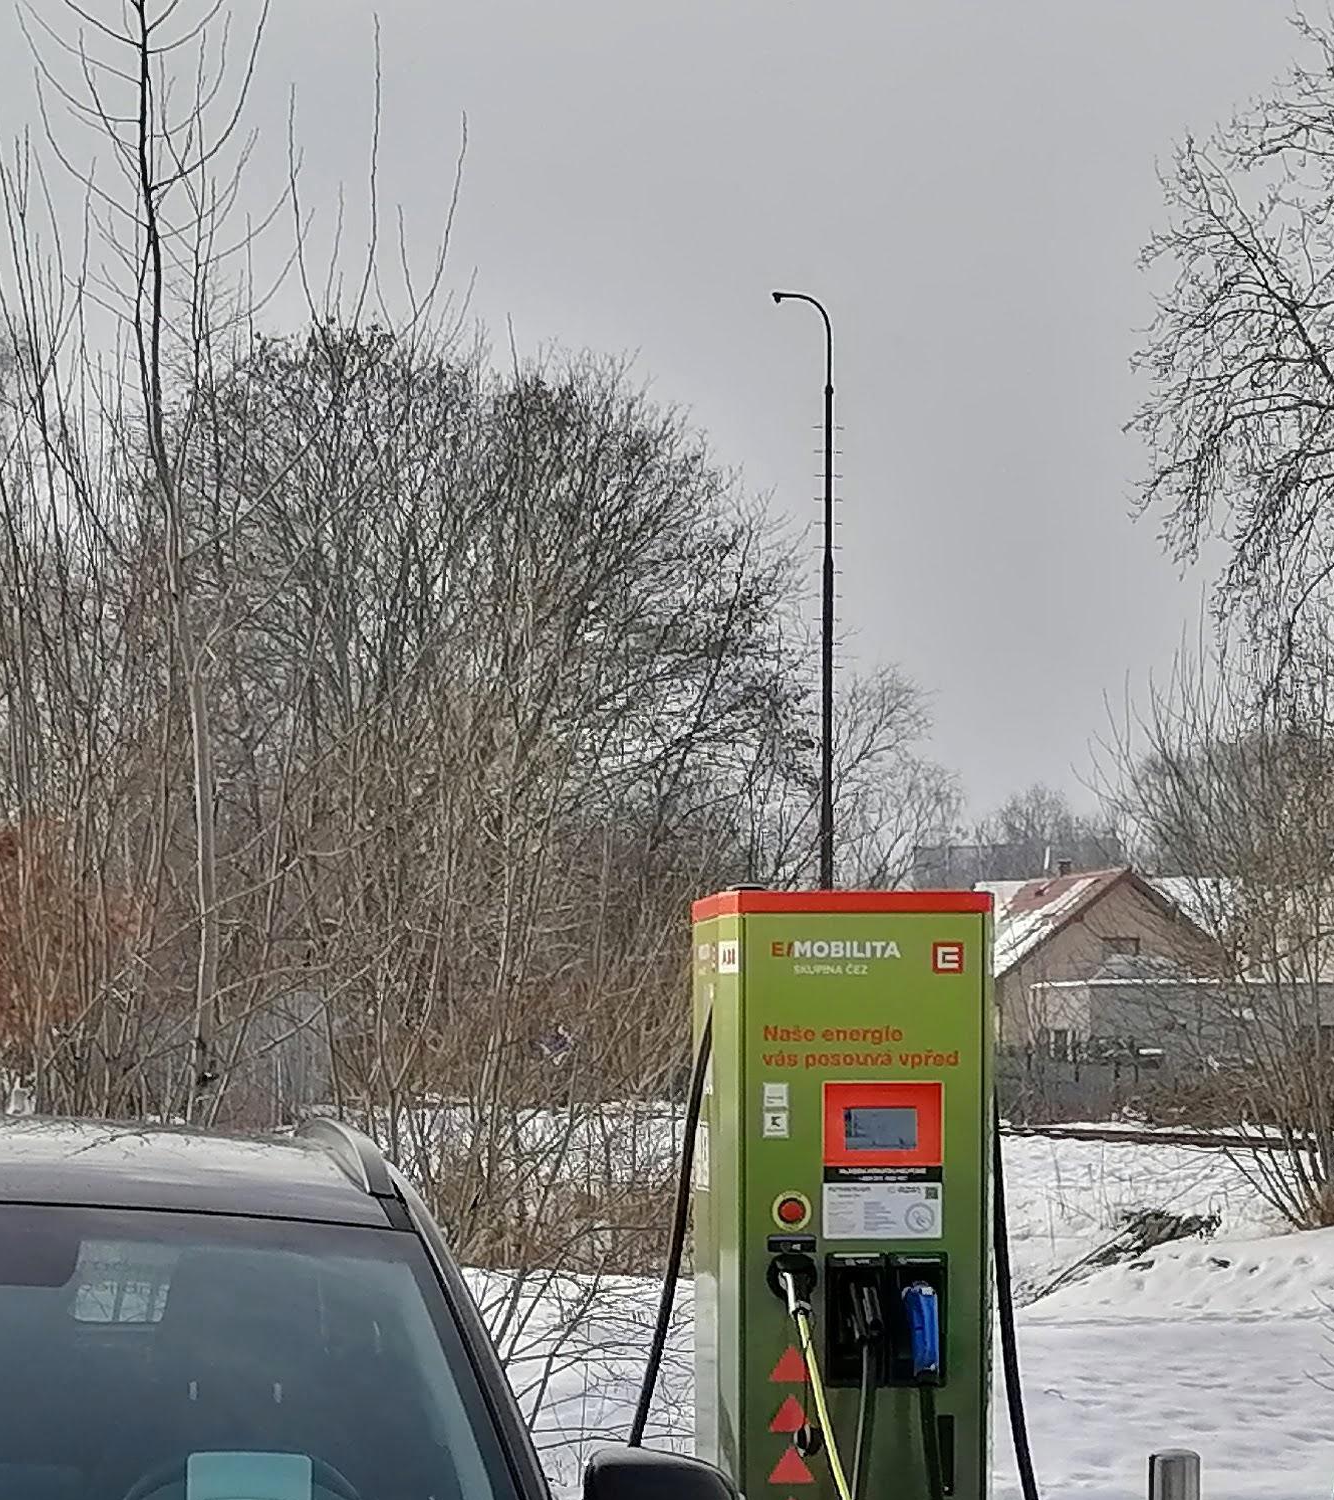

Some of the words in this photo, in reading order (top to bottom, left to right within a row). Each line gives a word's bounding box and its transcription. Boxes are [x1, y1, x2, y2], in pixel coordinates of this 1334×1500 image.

[763, 1025, 816, 1042] Naše
[821, 1025, 904, 1045] energie
[762, 1051, 799, 1068] vás
[805, 1051, 893, 1070] posouvá
[899, 1050, 959, 1070] vpřed
